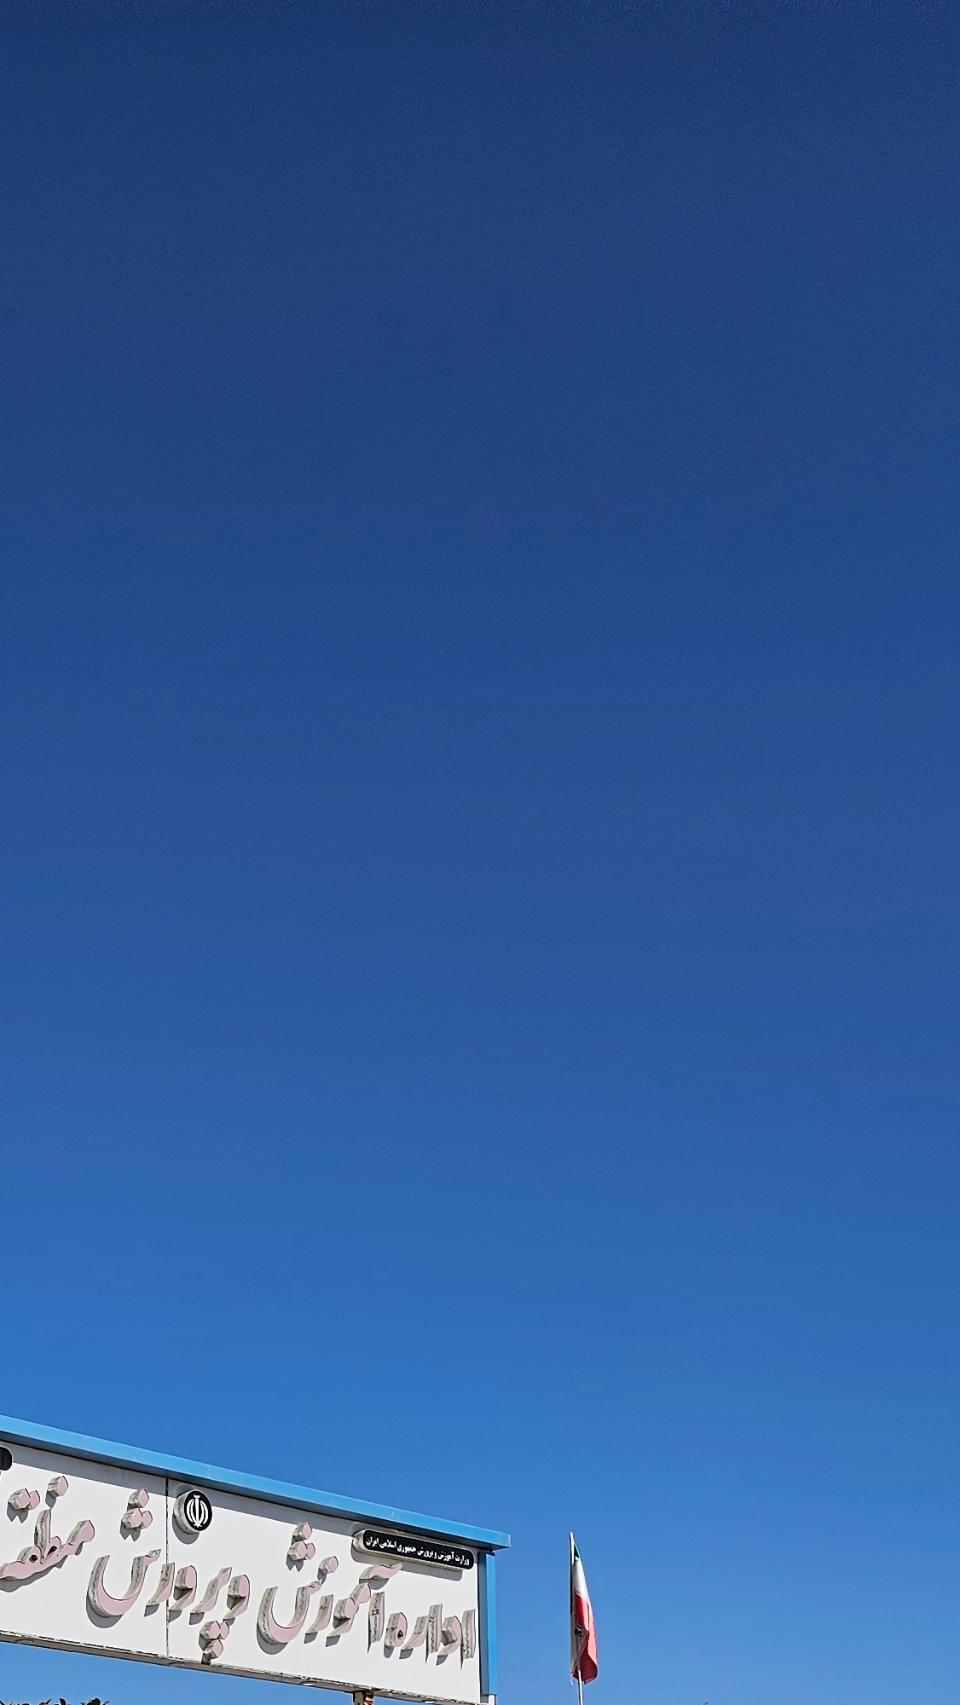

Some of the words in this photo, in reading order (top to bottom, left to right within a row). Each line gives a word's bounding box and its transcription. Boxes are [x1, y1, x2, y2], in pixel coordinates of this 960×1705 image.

[86, 1488, 233, 1660] پرورش
[224, 1574, 251, 1620] و
[257, 1521, 403, 1645] آموزش
[384, 1602, 477, 1660] اداره
